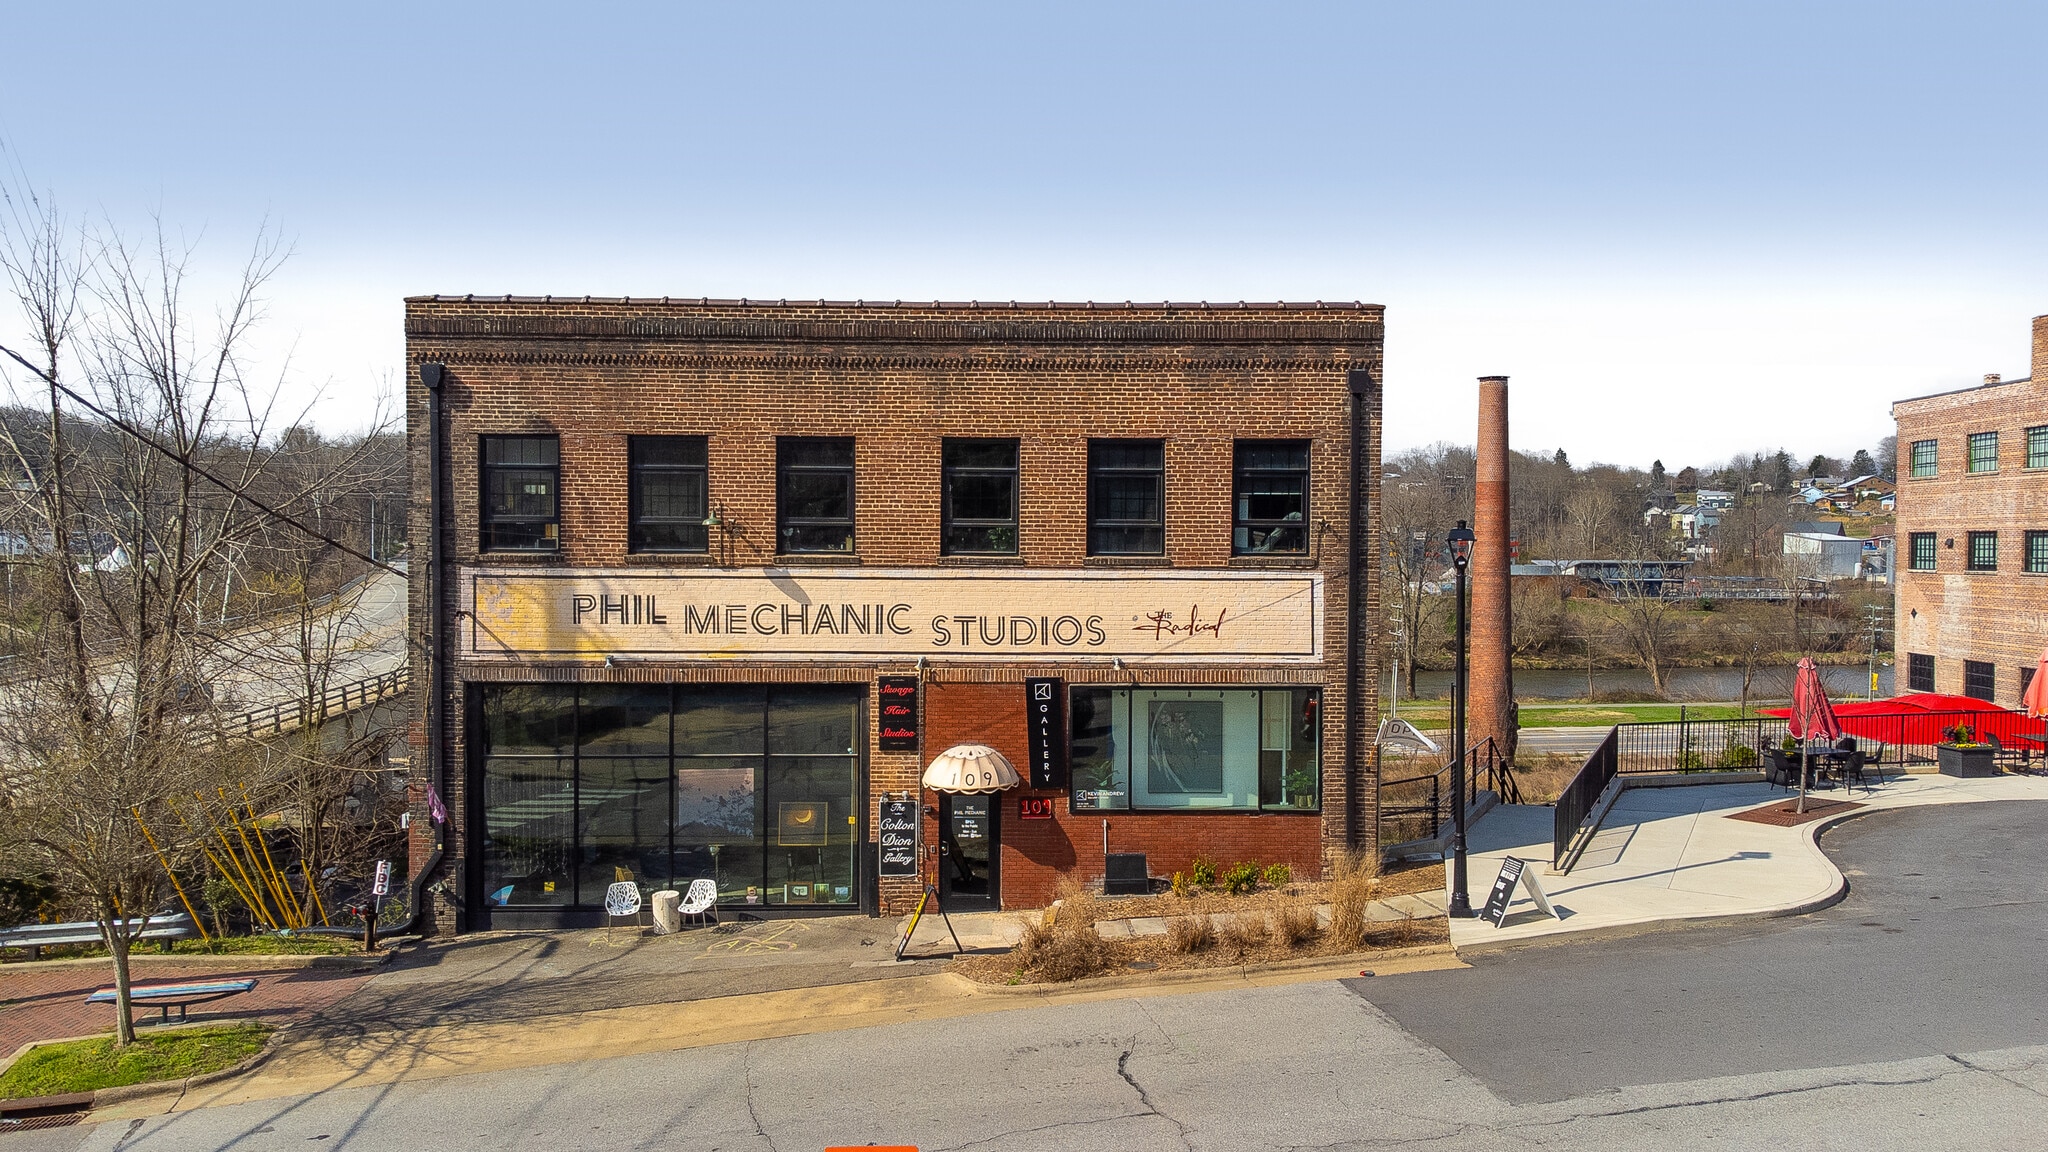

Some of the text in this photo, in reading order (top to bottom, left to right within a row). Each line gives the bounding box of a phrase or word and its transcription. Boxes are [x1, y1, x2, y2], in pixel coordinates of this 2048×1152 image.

[573, 594, 1106, 646] PHIL MECHANIC STUDIOS
[1155, 611, 1172, 619] THE
[1132, 604, 1227, 641] Radical
[880, 684, 915, 696] Savage
[884, 705, 911, 715] Hair
[880, 727, 916, 737] Studios
[1040, 704, 1050, 782] GALLERY
[952, 772, 992, 786] 109
[890, 803, 906, 812] The
[1021, 799, 1051, 815] 109
[881, 818, 915, 830] Colton
[882, 833, 913, 846] Dion
[883, 853, 914, 865] Gallery
[376, 862, 389, 894] FDC
